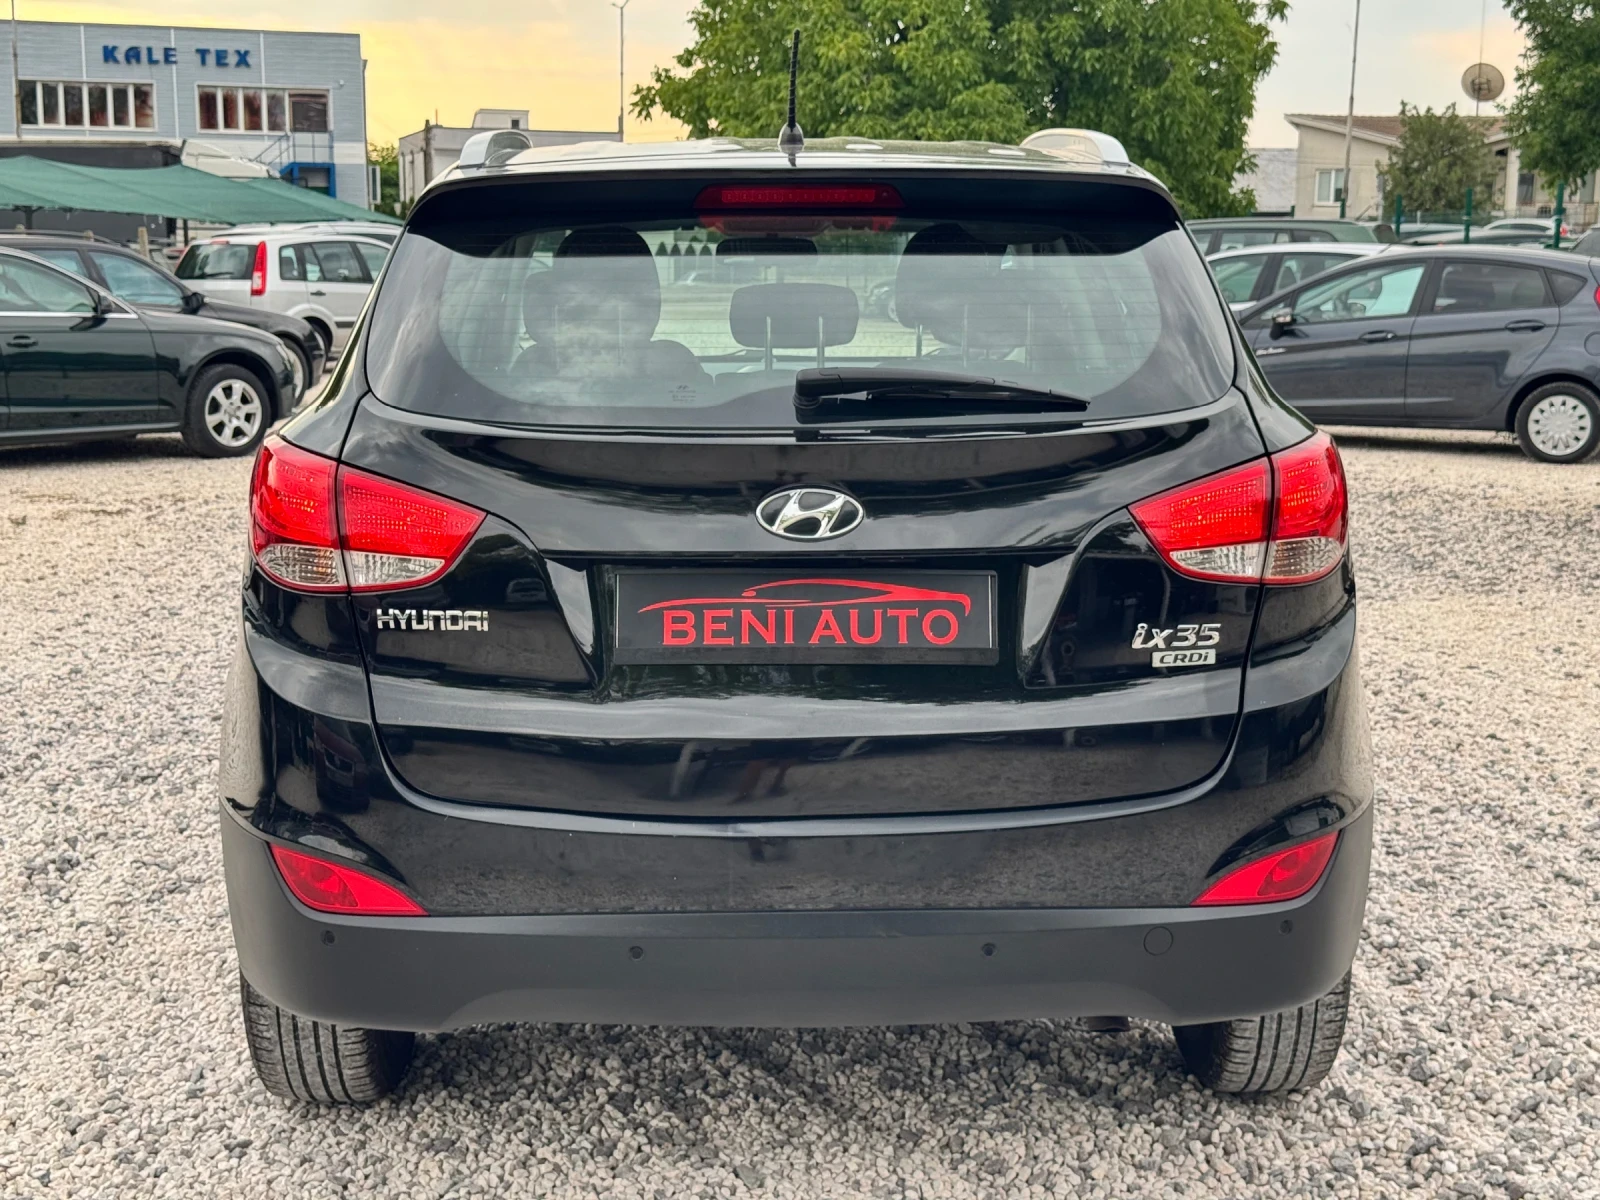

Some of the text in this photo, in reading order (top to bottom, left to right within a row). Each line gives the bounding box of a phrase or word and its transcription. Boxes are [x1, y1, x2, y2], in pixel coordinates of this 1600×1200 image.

[102, 45, 251, 68] KALE TEX
[376, 608, 489, 632] HYUNDAI
[662, 608, 959, 646] BENI AUTO
[1131, 622, 1222, 649] ix35
[1159, 651, 1210, 665] CRDi
